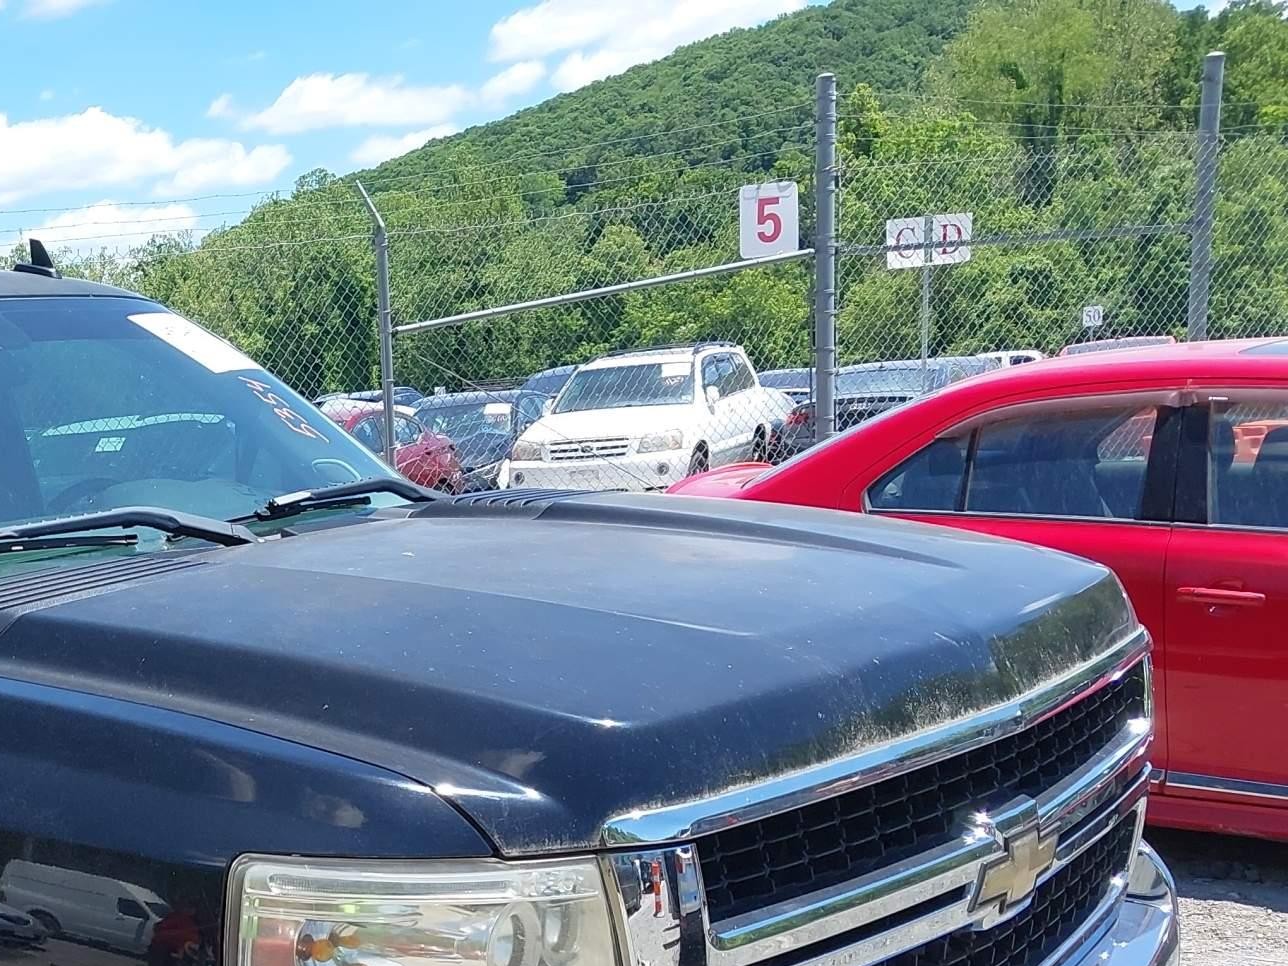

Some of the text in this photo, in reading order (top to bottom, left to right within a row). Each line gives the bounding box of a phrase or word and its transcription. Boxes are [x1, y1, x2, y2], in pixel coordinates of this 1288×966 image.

[756, 196, 783, 244] 5
[894, 227, 916, 259] C
[940, 223, 962, 255] D
[1085, 309, 1101, 321] 50
